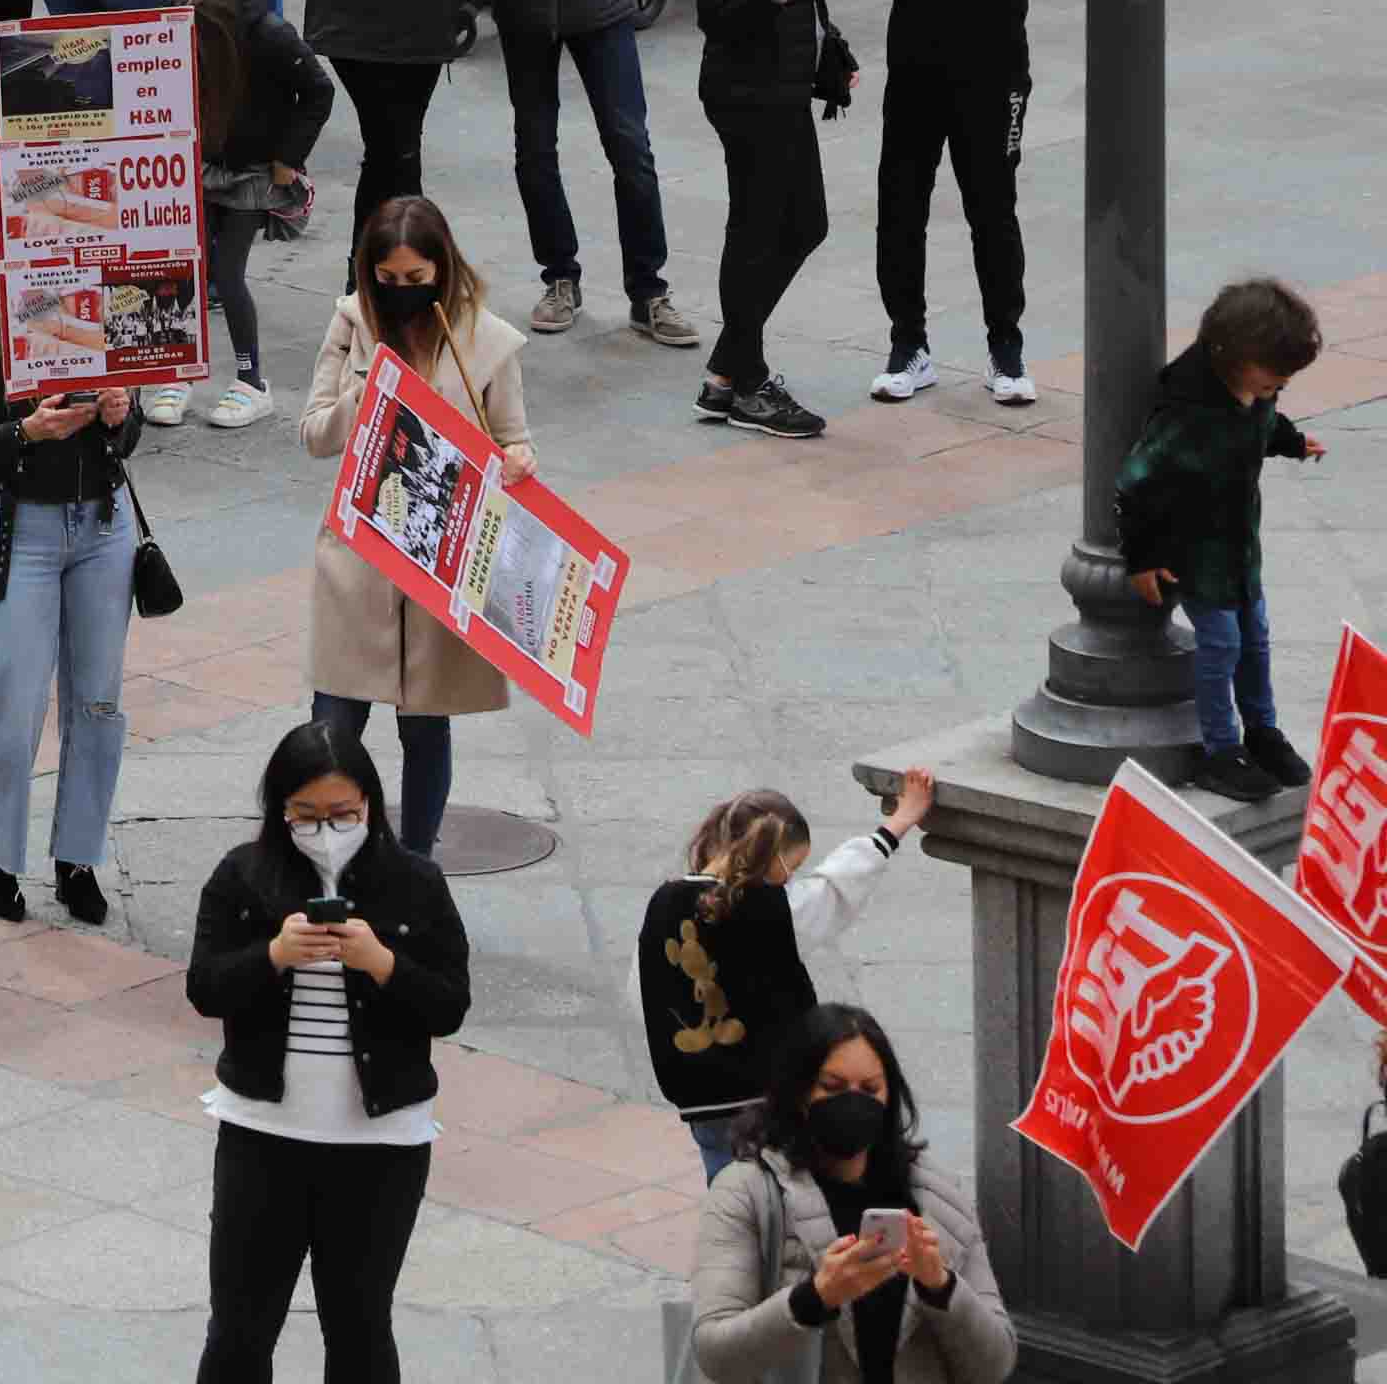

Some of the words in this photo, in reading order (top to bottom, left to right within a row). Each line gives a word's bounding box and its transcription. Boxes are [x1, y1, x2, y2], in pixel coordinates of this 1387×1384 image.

[123, 33, 152, 49] por
[158, 29, 173, 43] el
[70, 40, 103, 57] LUCHA
[117, 58, 181, 75] empleo
[137, 85, 157, 97] en
[130, 108, 172, 125] H&M
[119, 153, 186, 190] CCOO
[121, 208, 139, 229] en
[144, 197, 191, 227] Lucha
[24, 237, 58, 248] LOW
[65, 235, 105, 244] COST
[82, 249, 118, 258] CCOO
[28, 359, 56, 370] LOW
[61, 357, 94, 366] COST
[469, 509, 493, 588] NUESTROS
[477, 515, 502, 595] DERECHOS
[547, 638, 559, 660] NO
[567, 561, 577, 583] EN
[561, 595, 578, 641] VENTA
